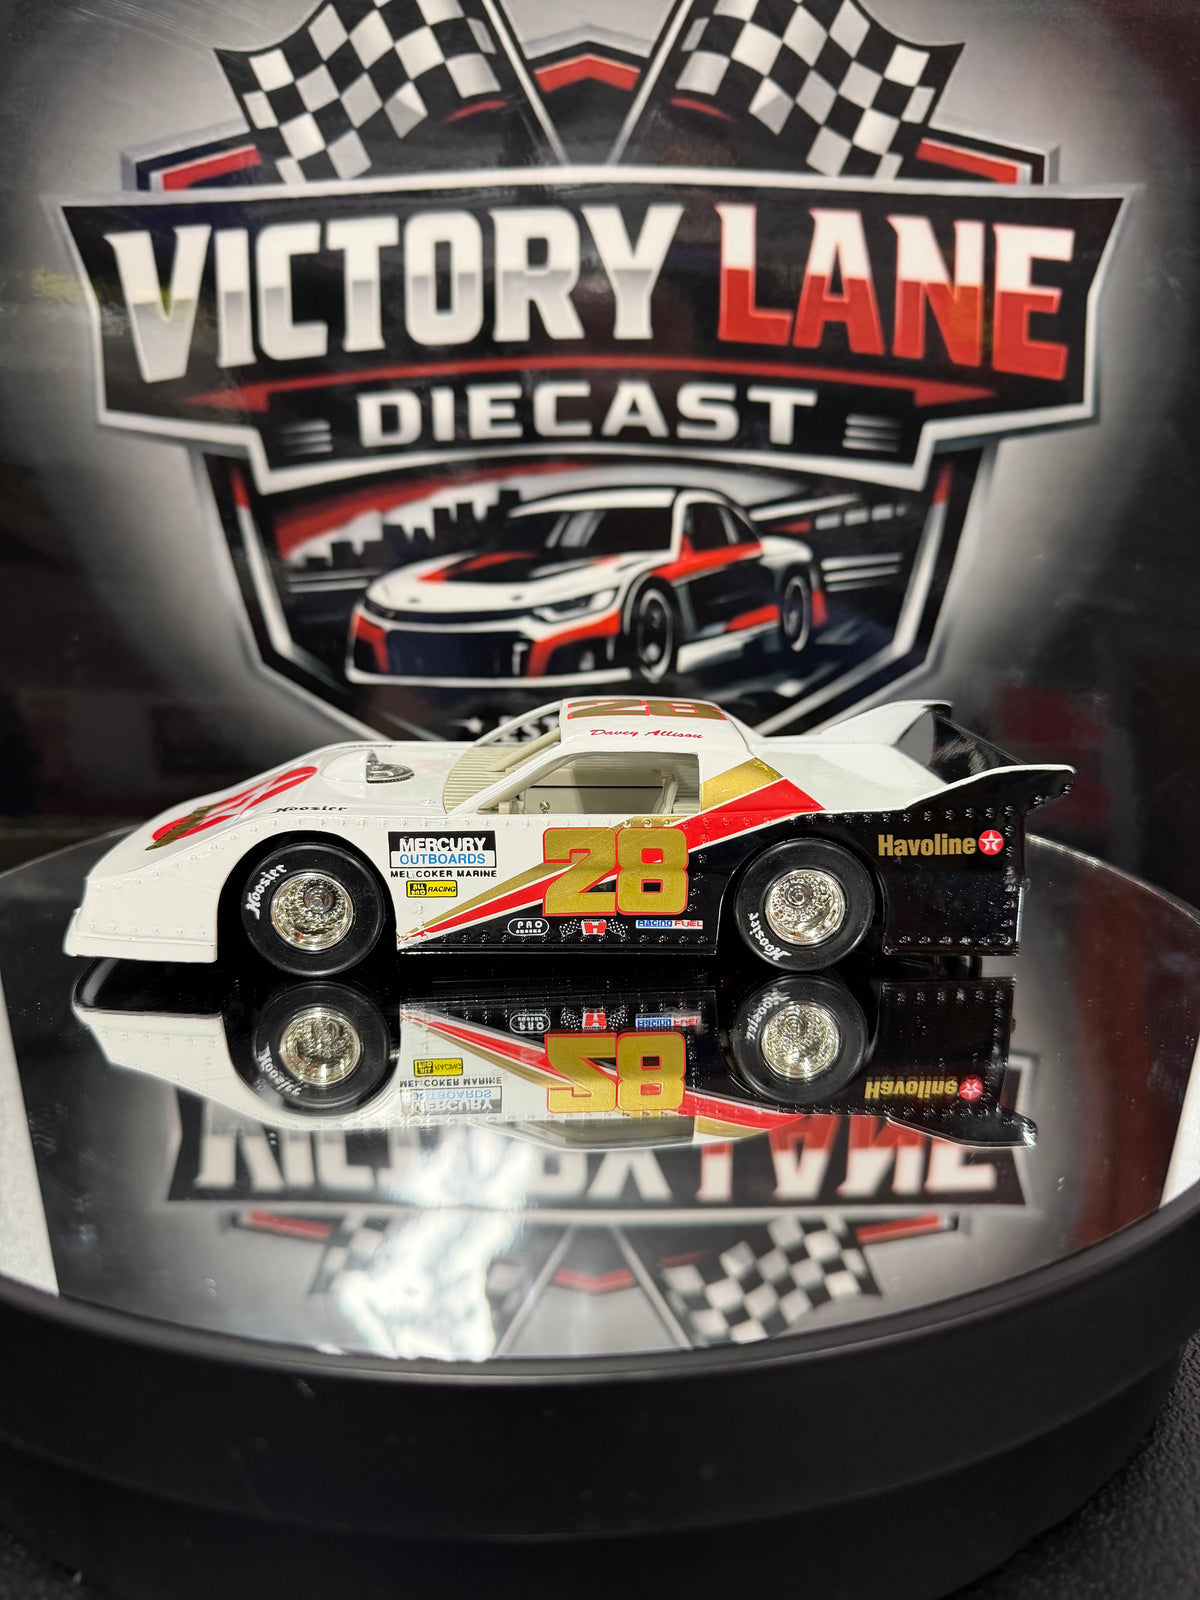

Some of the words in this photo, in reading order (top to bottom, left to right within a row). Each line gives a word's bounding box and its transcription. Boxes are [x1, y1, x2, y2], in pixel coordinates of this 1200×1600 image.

[102, 203, 685, 384] VICTORY
[715, 203, 1075, 380] LANE
[355, 380, 818, 449] DIECAST
[567, 699, 728, 720] 28
[590, 729, 640, 738] Davey
[644, 729, 704, 739] Allison
[399, 837, 487, 852] MERCURY
[877, 833, 977, 856] Havoline
[399, 853, 486, 865] OUTBOARDS
[416, 870, 453, 878] COKER
[456, 870, 497, 878] MARINE
[542, 827, 689, 917] 28
[245, 864, 287, 920] Hoosier
[517, 920, 543, 929] PRO
[637, 920, 672, 928] Racing
[674, 920, 703, 928] FUEL
[748, 912, 792, 961] Hoosier
